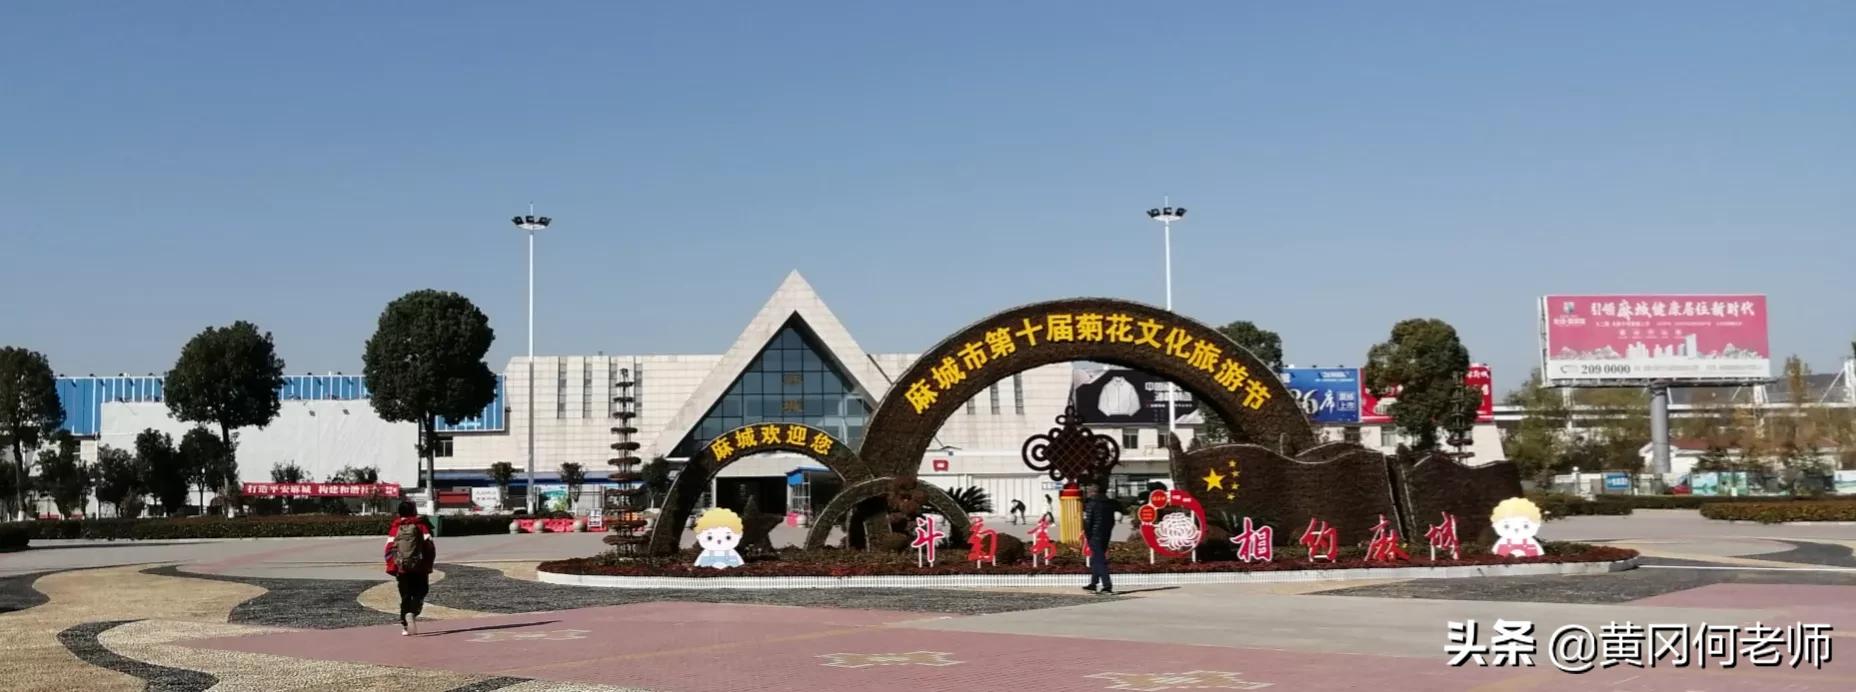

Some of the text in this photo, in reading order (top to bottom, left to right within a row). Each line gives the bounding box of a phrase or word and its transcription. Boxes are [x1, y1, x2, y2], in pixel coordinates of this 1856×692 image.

[904, 313, 1272, 414] 麻城市第十届菊花文化旅游节
[710, 424, 834, 461] 麻城欢迎您
[247, 484, 312, 494] 打造平安麻城
